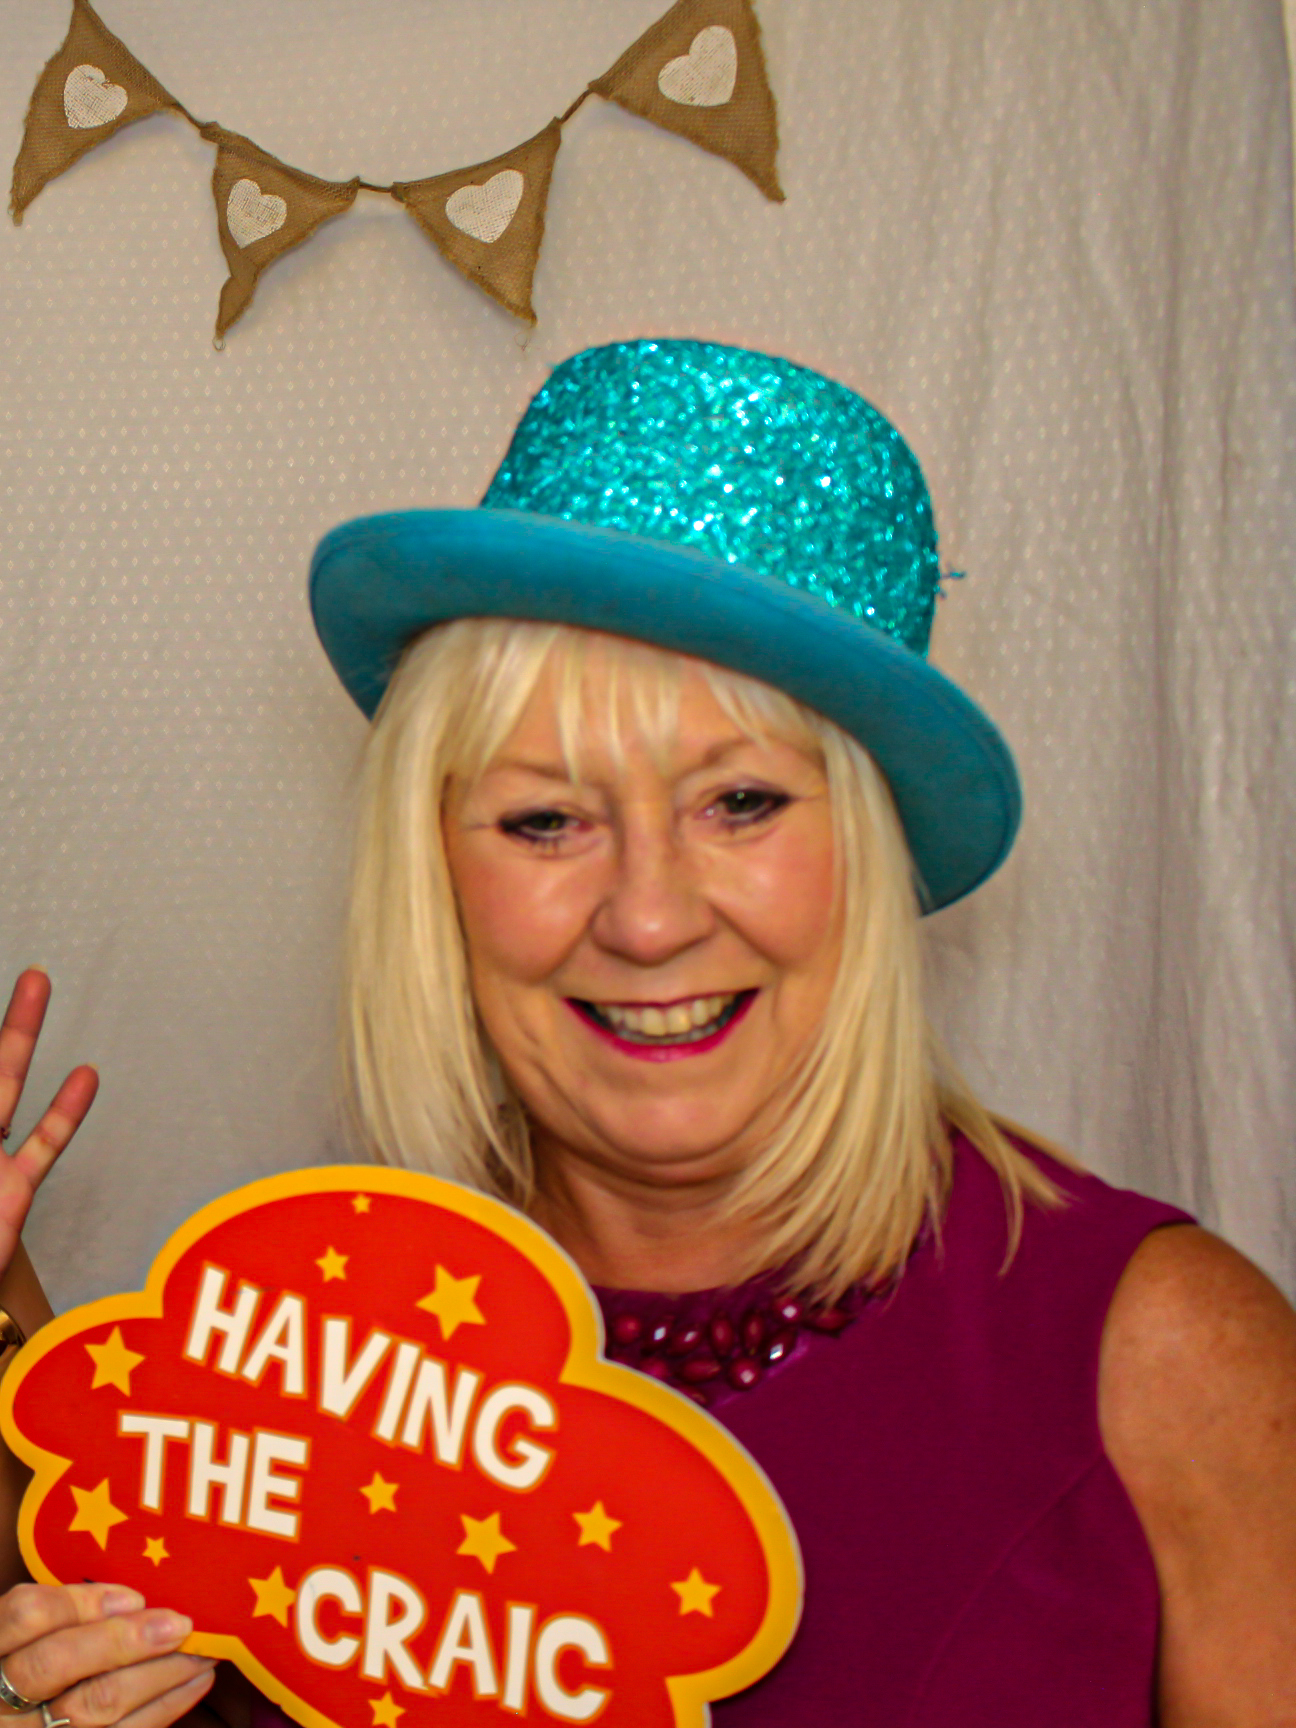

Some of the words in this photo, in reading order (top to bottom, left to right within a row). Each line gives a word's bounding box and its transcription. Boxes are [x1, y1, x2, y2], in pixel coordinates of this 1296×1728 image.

[185, 1264, 556, 1490] HAVING
[119, 1412, 308, 1539] THE
[296, 1567, 611, 1722] CRAIC
